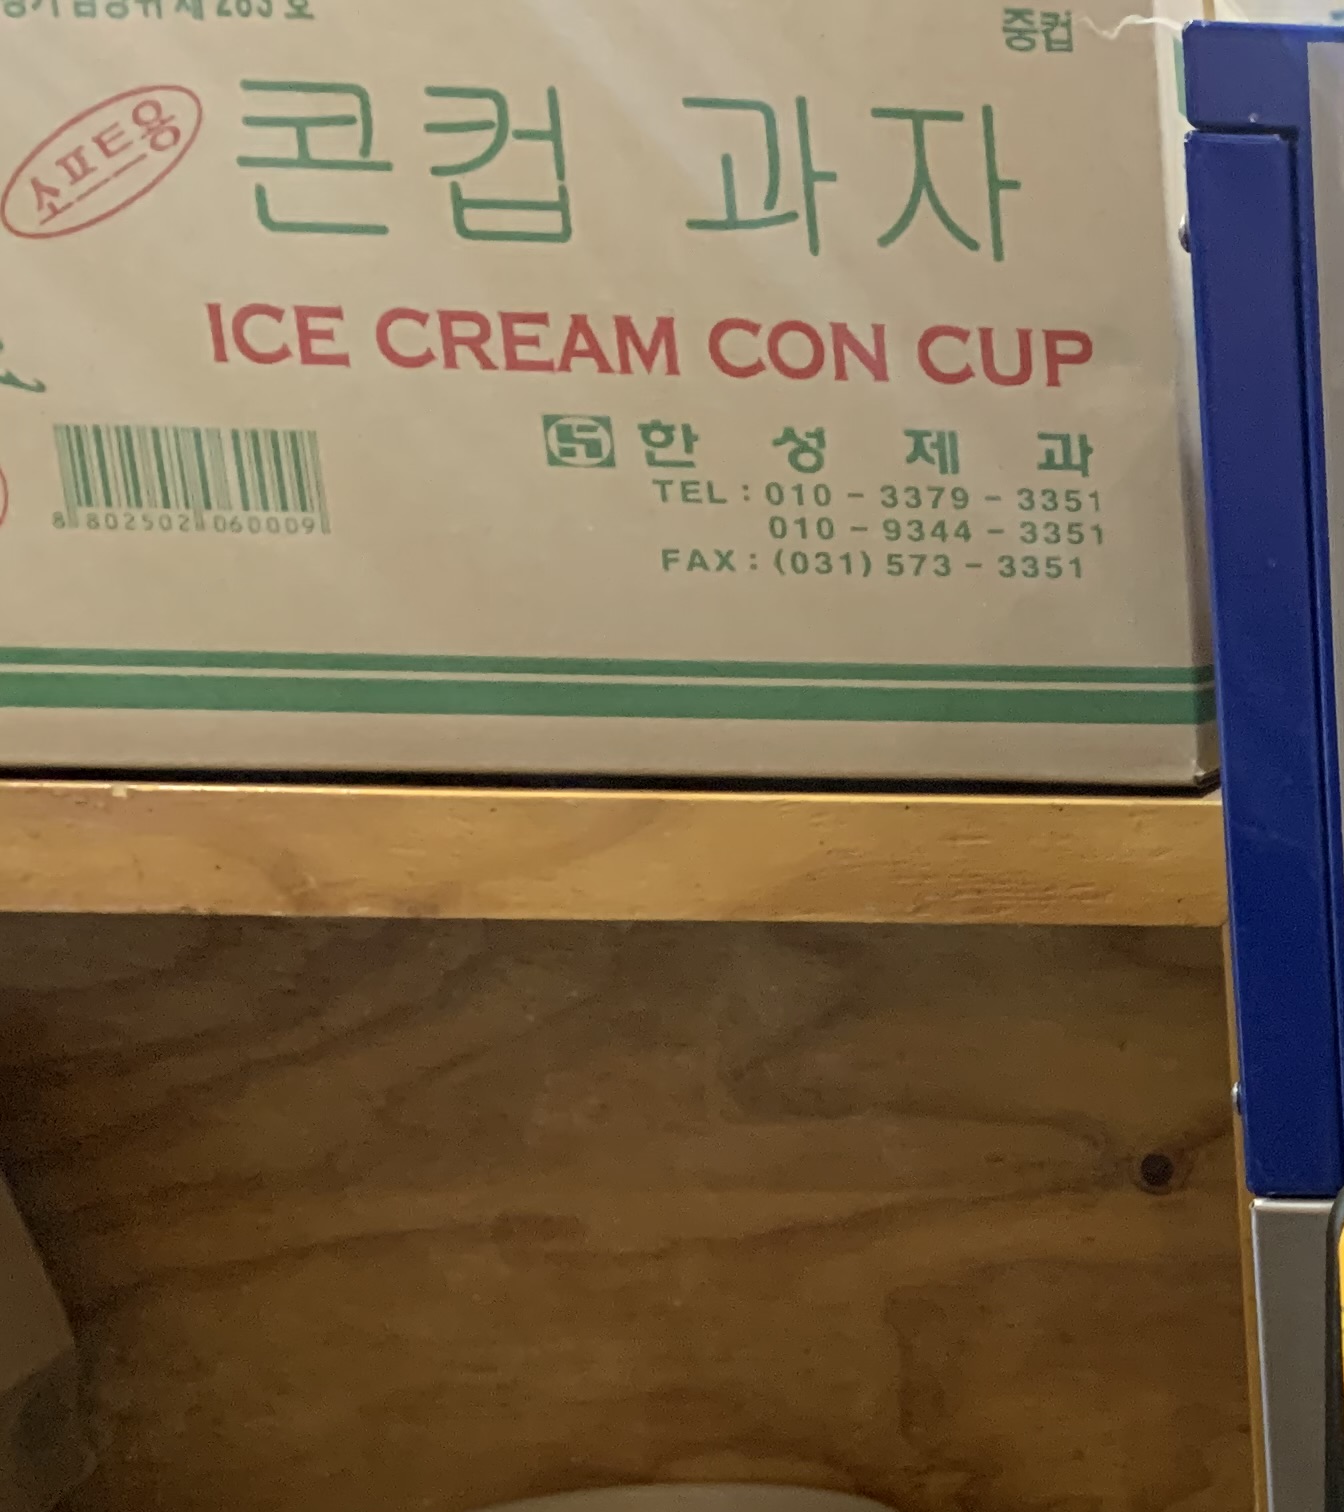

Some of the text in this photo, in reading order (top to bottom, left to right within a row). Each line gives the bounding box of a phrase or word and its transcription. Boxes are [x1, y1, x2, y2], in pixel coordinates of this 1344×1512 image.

[1003, 8, 1074, 53] 중컵
[27, 98, 182, 226] 소프트용
[237, 80, 1021, 262] 콘컵 과자
[205, 302, 1093, 388] ICE CREAM CON CUP
